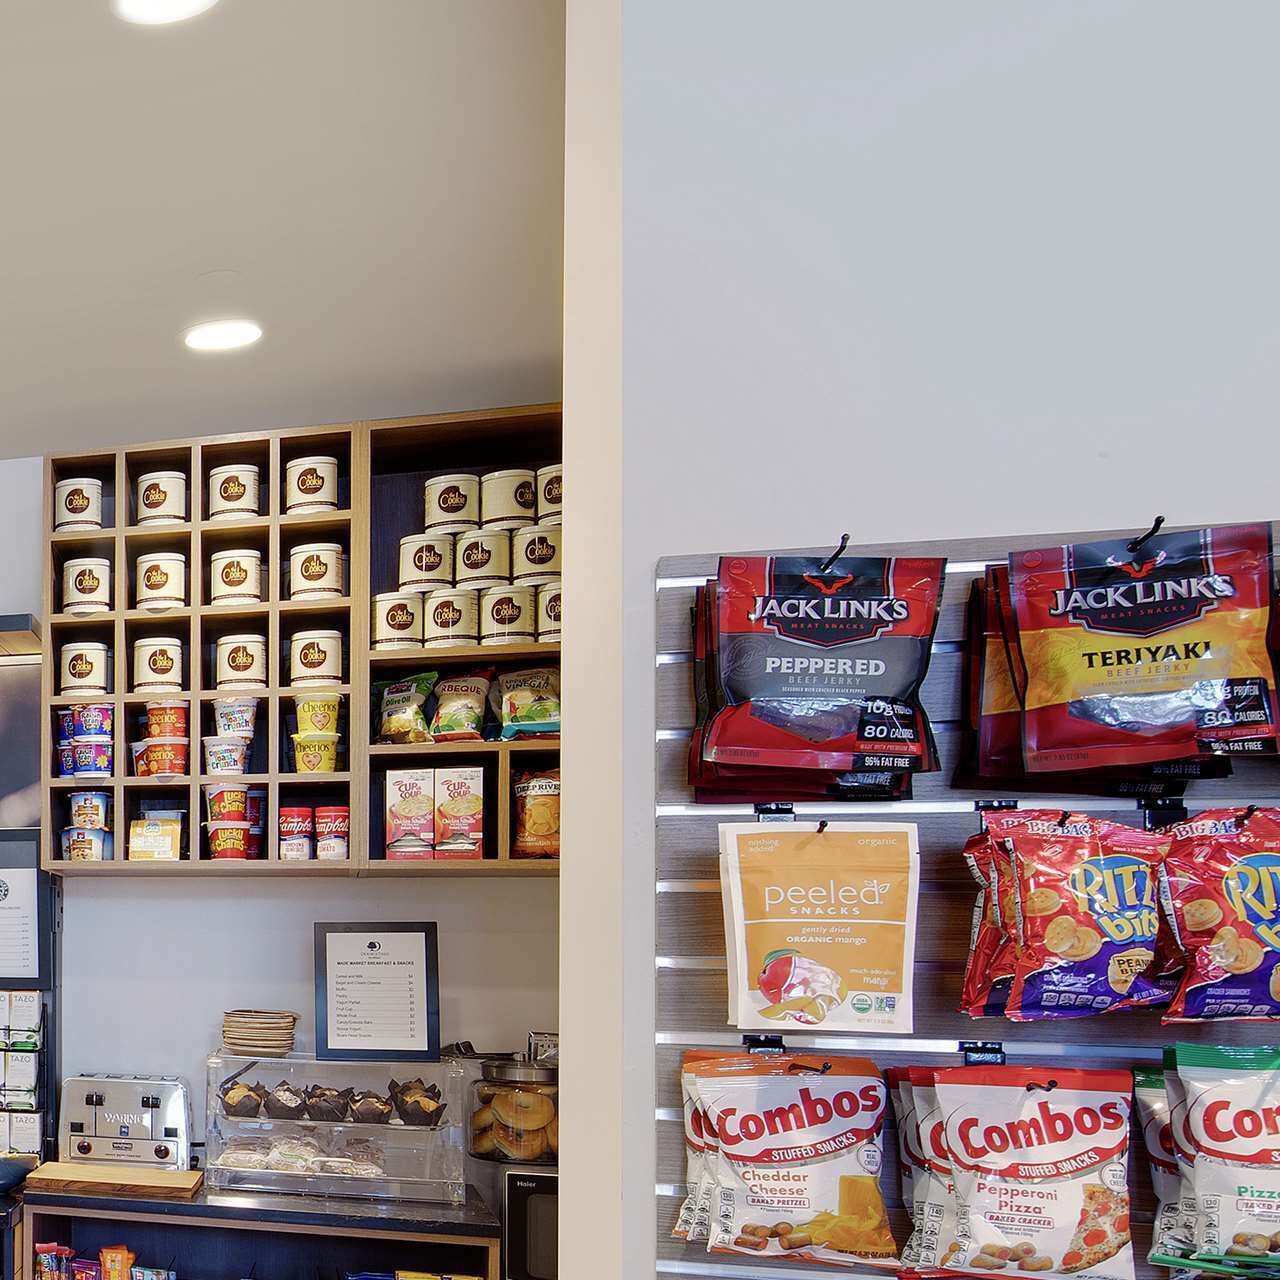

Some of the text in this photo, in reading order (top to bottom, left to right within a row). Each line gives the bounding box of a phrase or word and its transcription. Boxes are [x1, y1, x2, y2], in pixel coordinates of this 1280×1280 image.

[1049, 575, 1235, 615] JACK LINK'S
[753, 596, 909, 622] JACK LINK'S
[1100, 604, 1186, 620] MEAT SNACKS
[1082, 640, 1212, 669] TERIYAKI
[764, 656, 887, 676] PEPPERED
[1106, 662, 1191, 678] BEEF JERKY
[505, 680, 550, 691] VINEGAR
[788, 675, 862, 686] BEEF JERKY
[1234, 710, 1266, 722] CALORIES
[864, 725, 888, 738] 80
[1229, 740, 1263, 751] FAT FREE
[864, 756, 910, 768] 96% FAT FREE
[1027, 820, 1057, 835] BIG
[1175, 823, 1207, 840] BIG
[857, 838, 897, 848] organic
[765, 879, 879, 912] peeled
[1073, 862, 1157, 914] RITZ
[789, 906, 861, 915] SNACKS
[1100, 908, 1159, 942] bits
[786, 936, 867, 945] ORGANIC mango
[14, 995, 35, 1003] TAZO
[10, 1055, 31, 1063] TAZO
[716, 1084, 883, 1146] Combos
[957, 1100, 1125, 1159] Combos
[771, 1132, 857, 1161] STUFFED SNACKS
[1018, 1151, 1100, 1178] STUFFED SNACKS
[741, 1169, 809, 1183] Cheddar
[517, 1180, 537, 1188] Haier
[749, 1183, 804, 1197] Cheese
[976, 1182, 1059, 1201] Pepperoni
[776, 1198, 807, 1207] PRETZEL
[998, 1200, 1043, 1215] Pizza
[988, 1213, 1054, 1228] BAKED CRACKER
